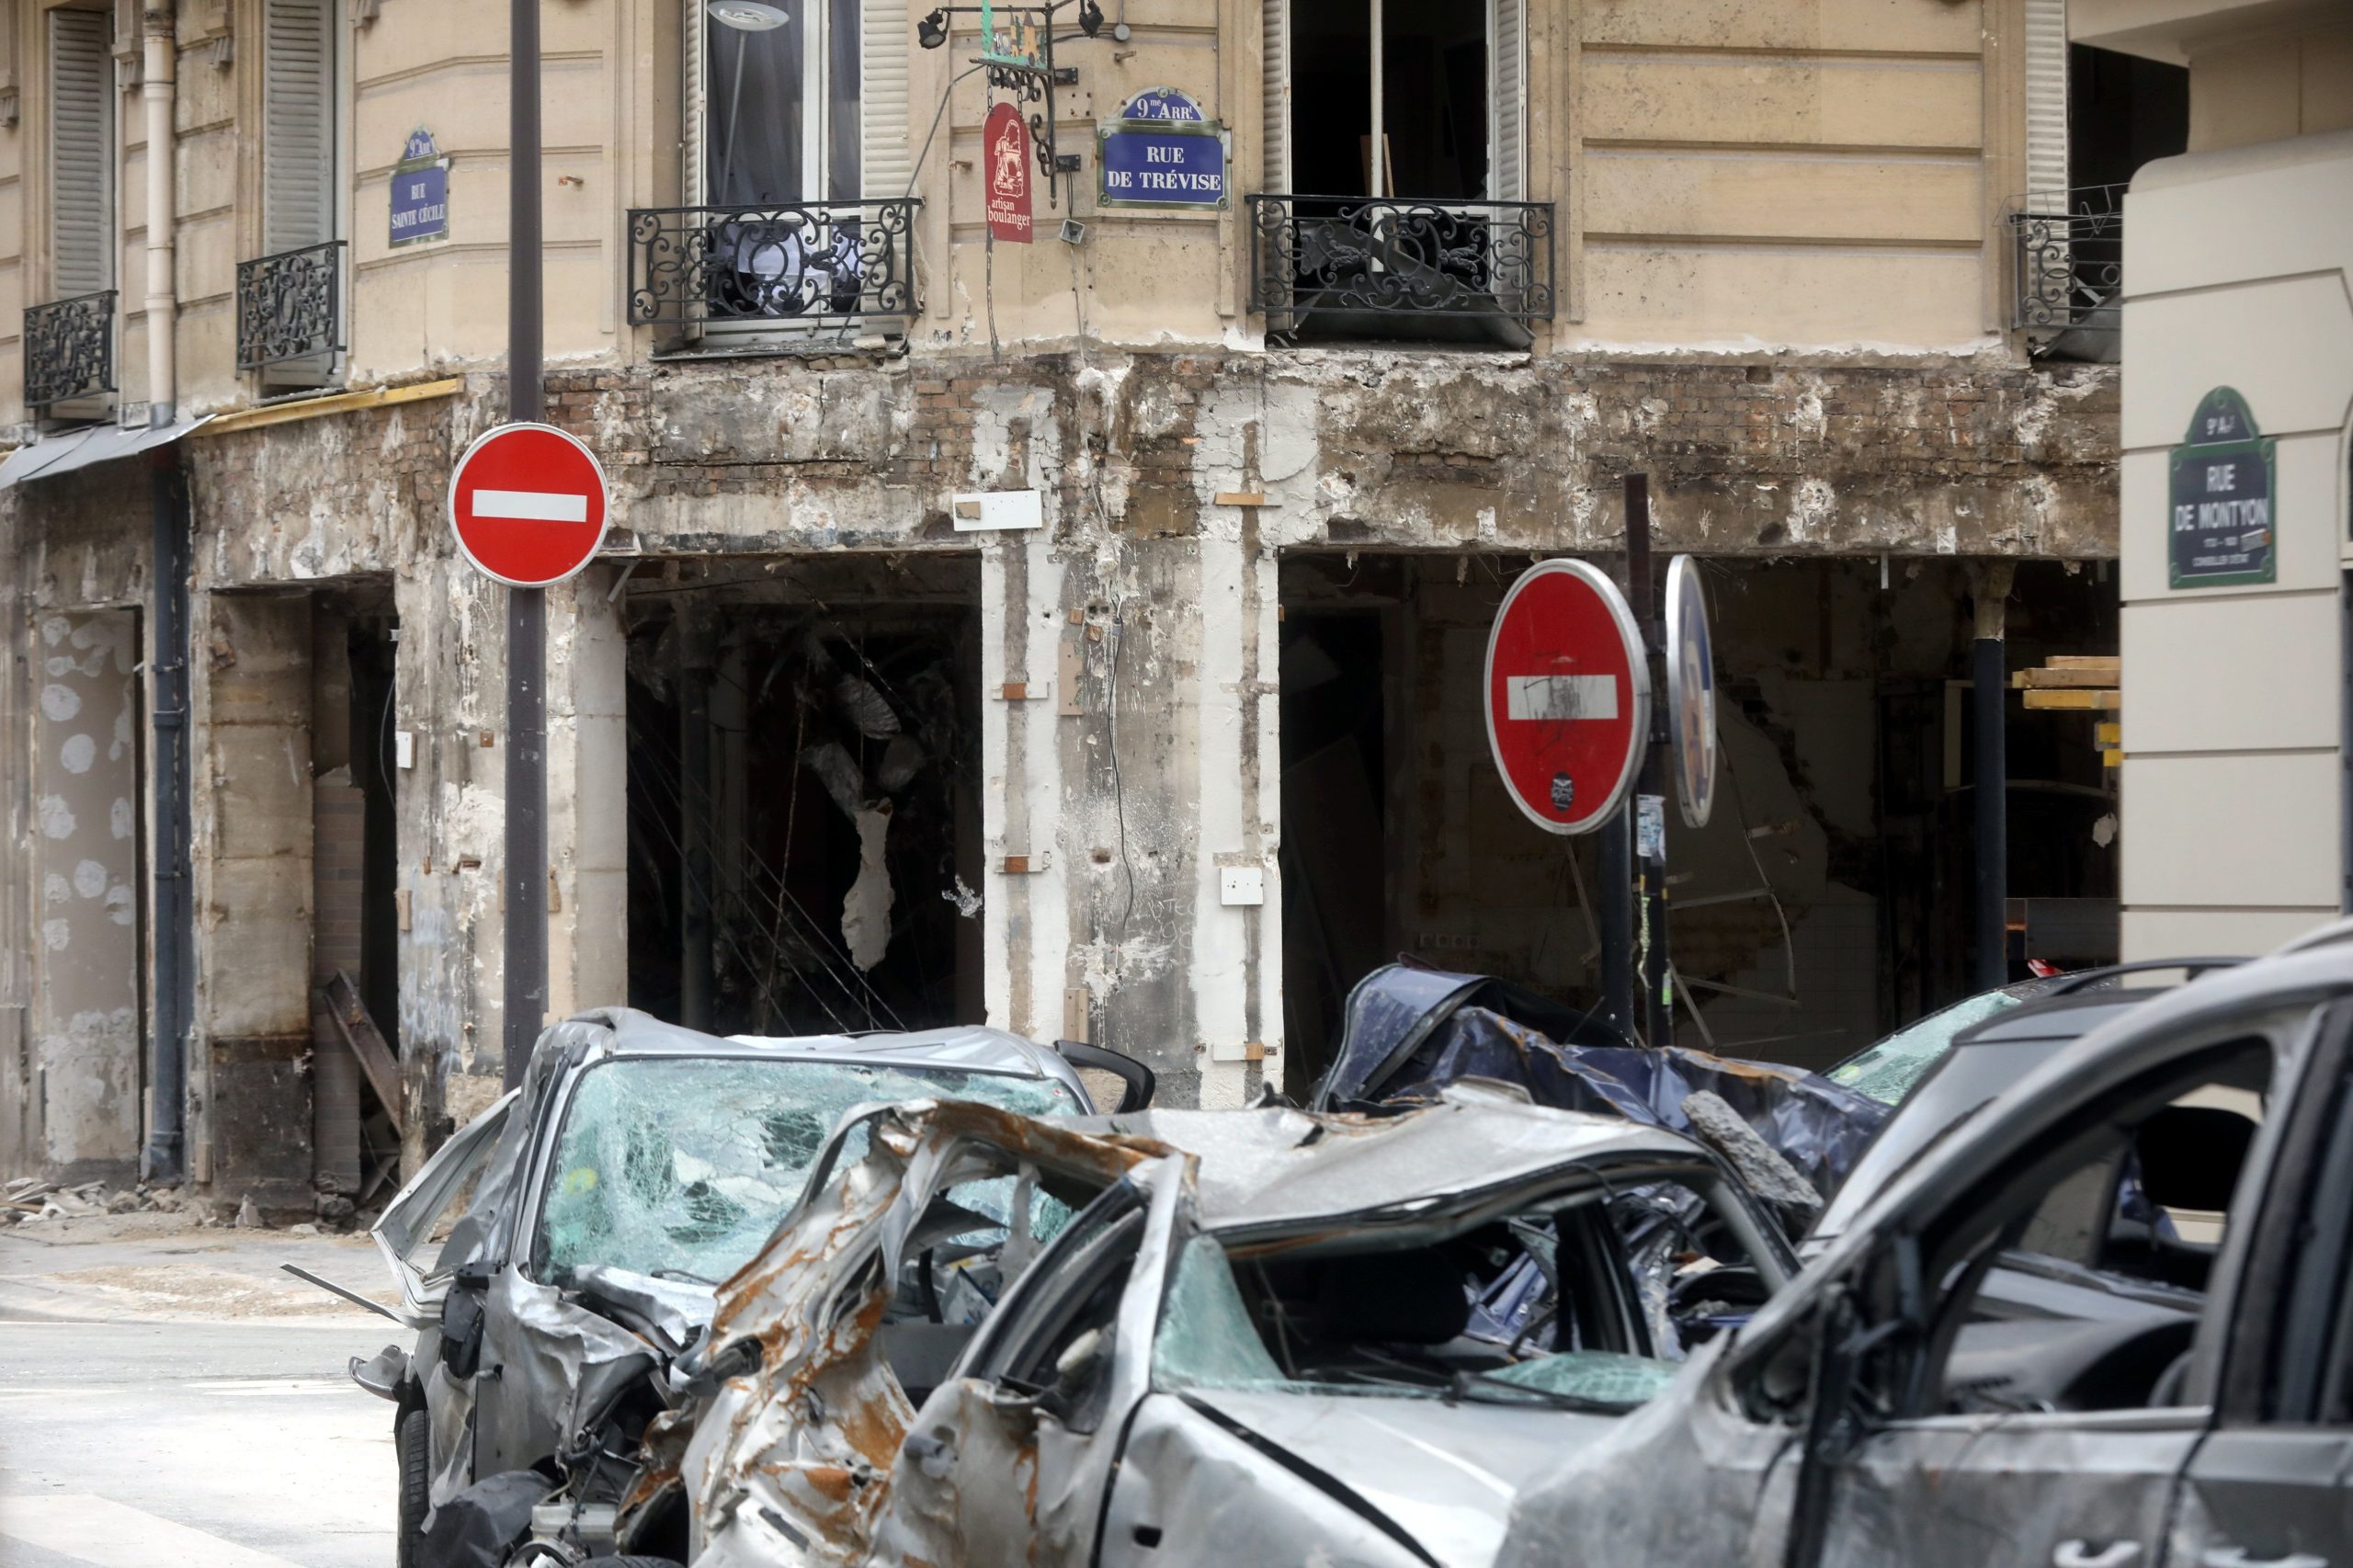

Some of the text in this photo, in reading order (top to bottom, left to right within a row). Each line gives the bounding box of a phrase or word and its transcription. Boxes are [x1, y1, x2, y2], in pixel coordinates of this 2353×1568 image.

[1146, 146, 1185, 164] RUE
[411, 183, 426, 200] RUE
[1108, 169, 1222, 191] DE TRÉVISE
[392, 202, 445, 230] SAINTE CÉCILE
[992, 197, 1015, 211] artisan
[987, 205, 1030, 231] boulanger
[2207, 463, 2236, 494] RUE
[2175, 497, 2269, 532] DE MONTYON
